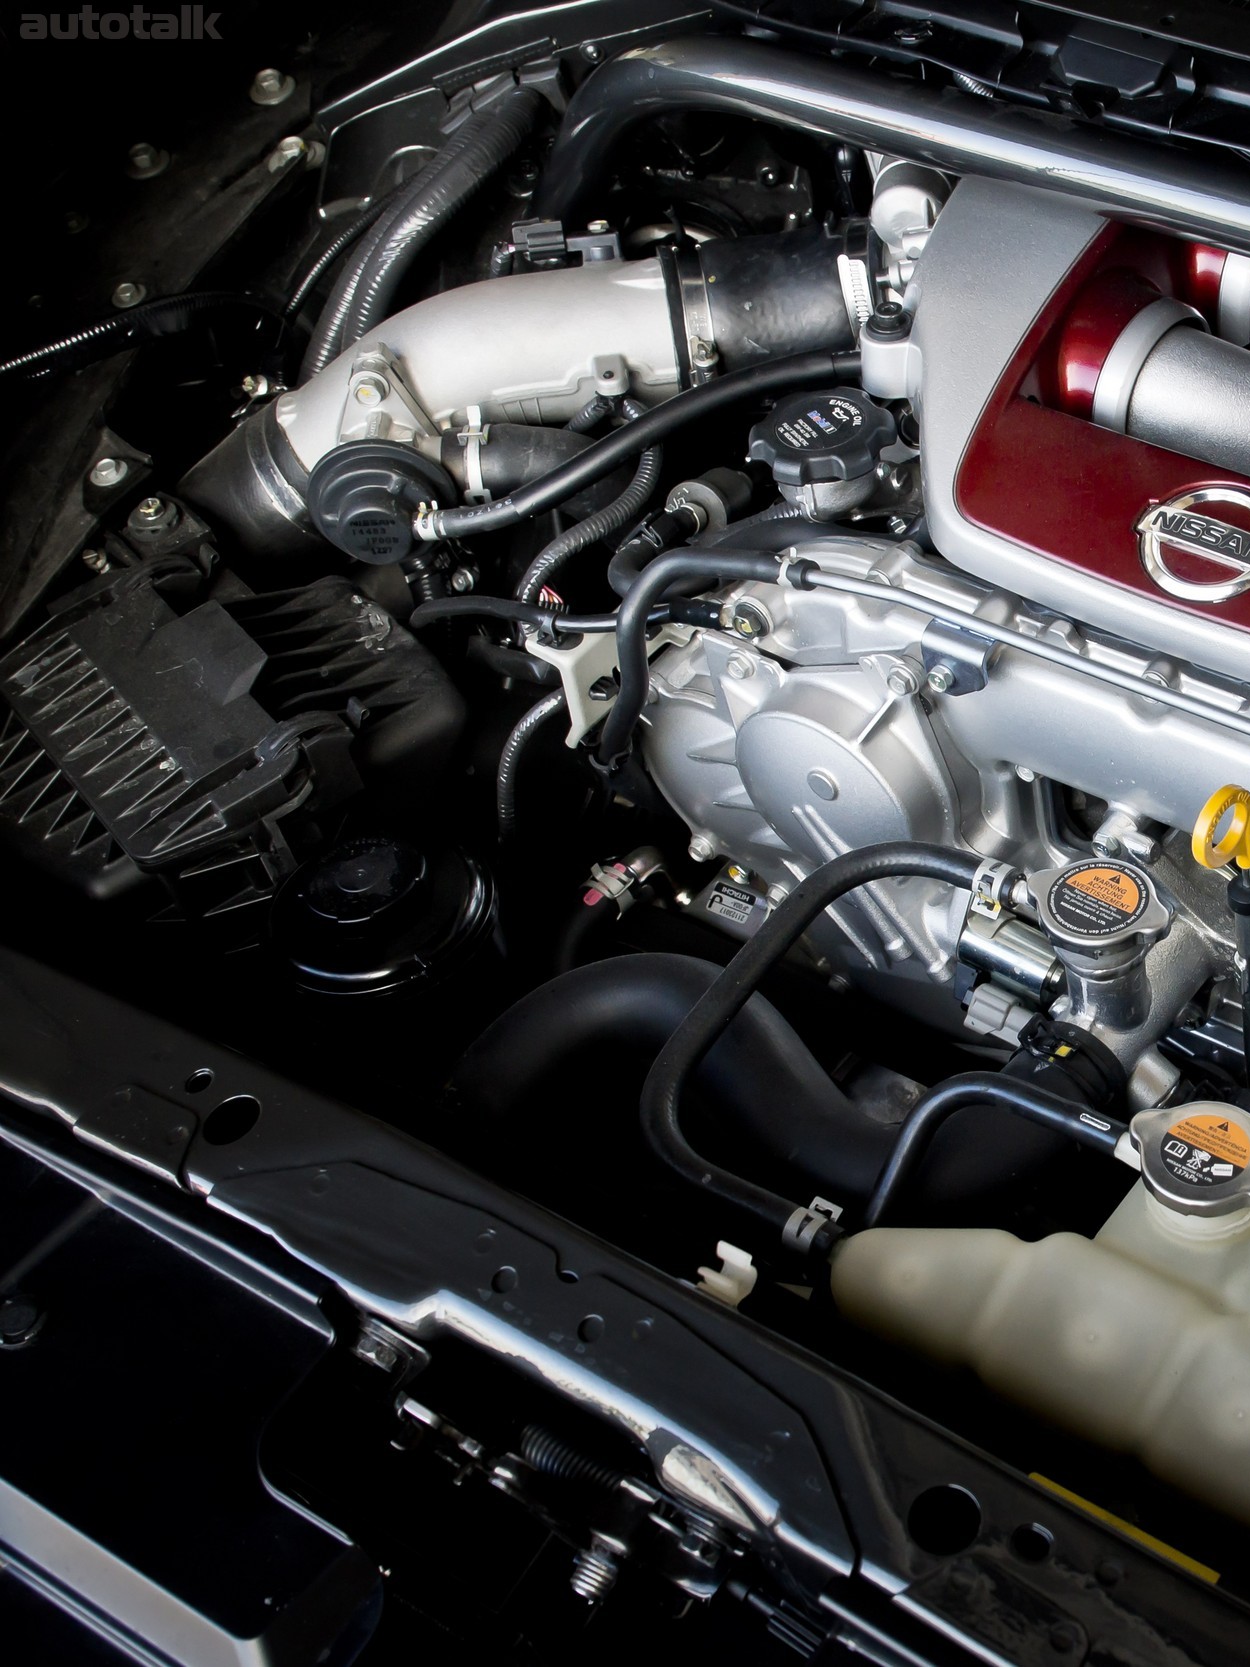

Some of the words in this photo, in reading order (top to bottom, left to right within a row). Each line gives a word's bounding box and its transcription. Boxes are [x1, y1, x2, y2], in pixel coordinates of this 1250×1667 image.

[829, 399, 860, 415] ENGINE
[853, 415, 862, 426] OIL
[722, 886, 750, 902] HITACHI
[1087, 880, 1123, 900] ACHTUNG
[1094, 876, 1127, 894] WARNING
[1071, 880, 1130, 910] AVERTISSEMENT
[1060, 901, 1075, 910] NISSAN
[1173, 1167, 1198, 1182] 137kPa
